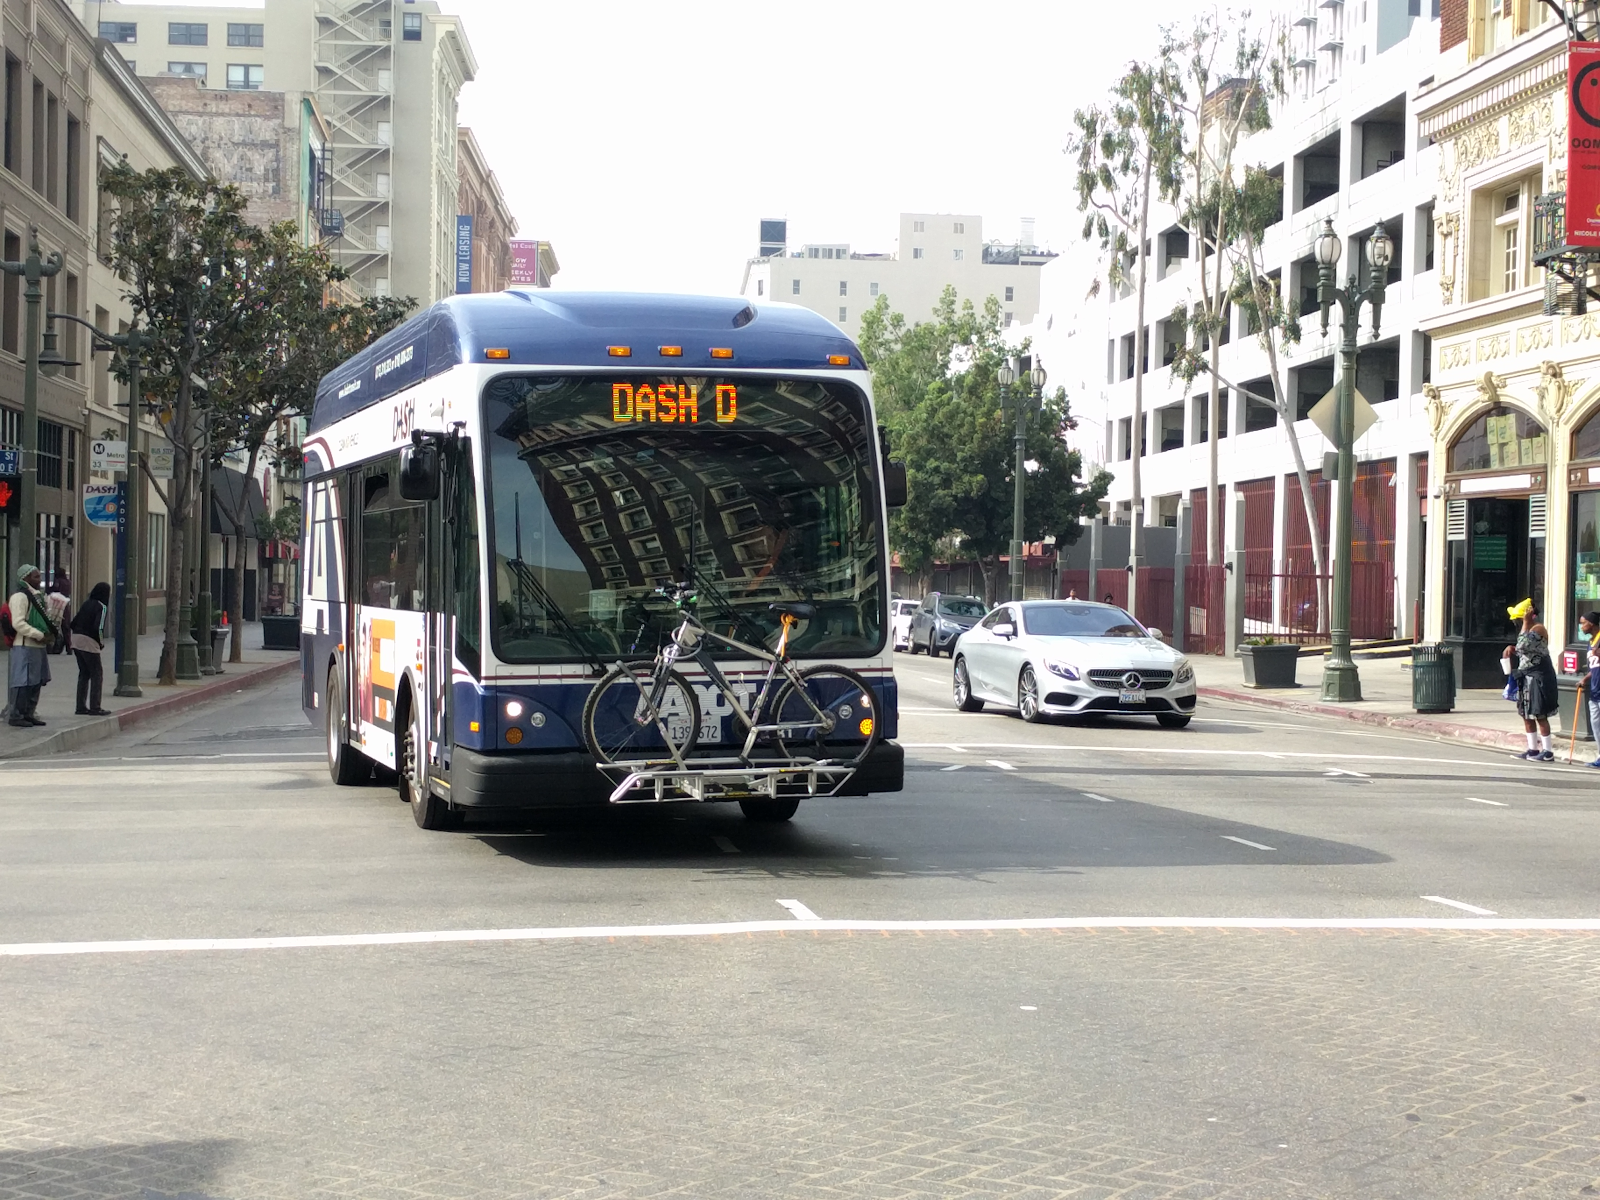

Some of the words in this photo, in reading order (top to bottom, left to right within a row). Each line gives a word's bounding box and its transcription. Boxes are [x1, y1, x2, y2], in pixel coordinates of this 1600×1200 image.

[458, 225, 470, 260] LEASING
[458, 263, 470, 283] NOW
[613, 383, 698, 422] DASH
[716, 384, 738, 422] D
[392, 398, 416, 443] DASH
[5, 451, 14, 460] St
[8, 463, 14, 472] E
[85, 485, 117, 494] DASH
